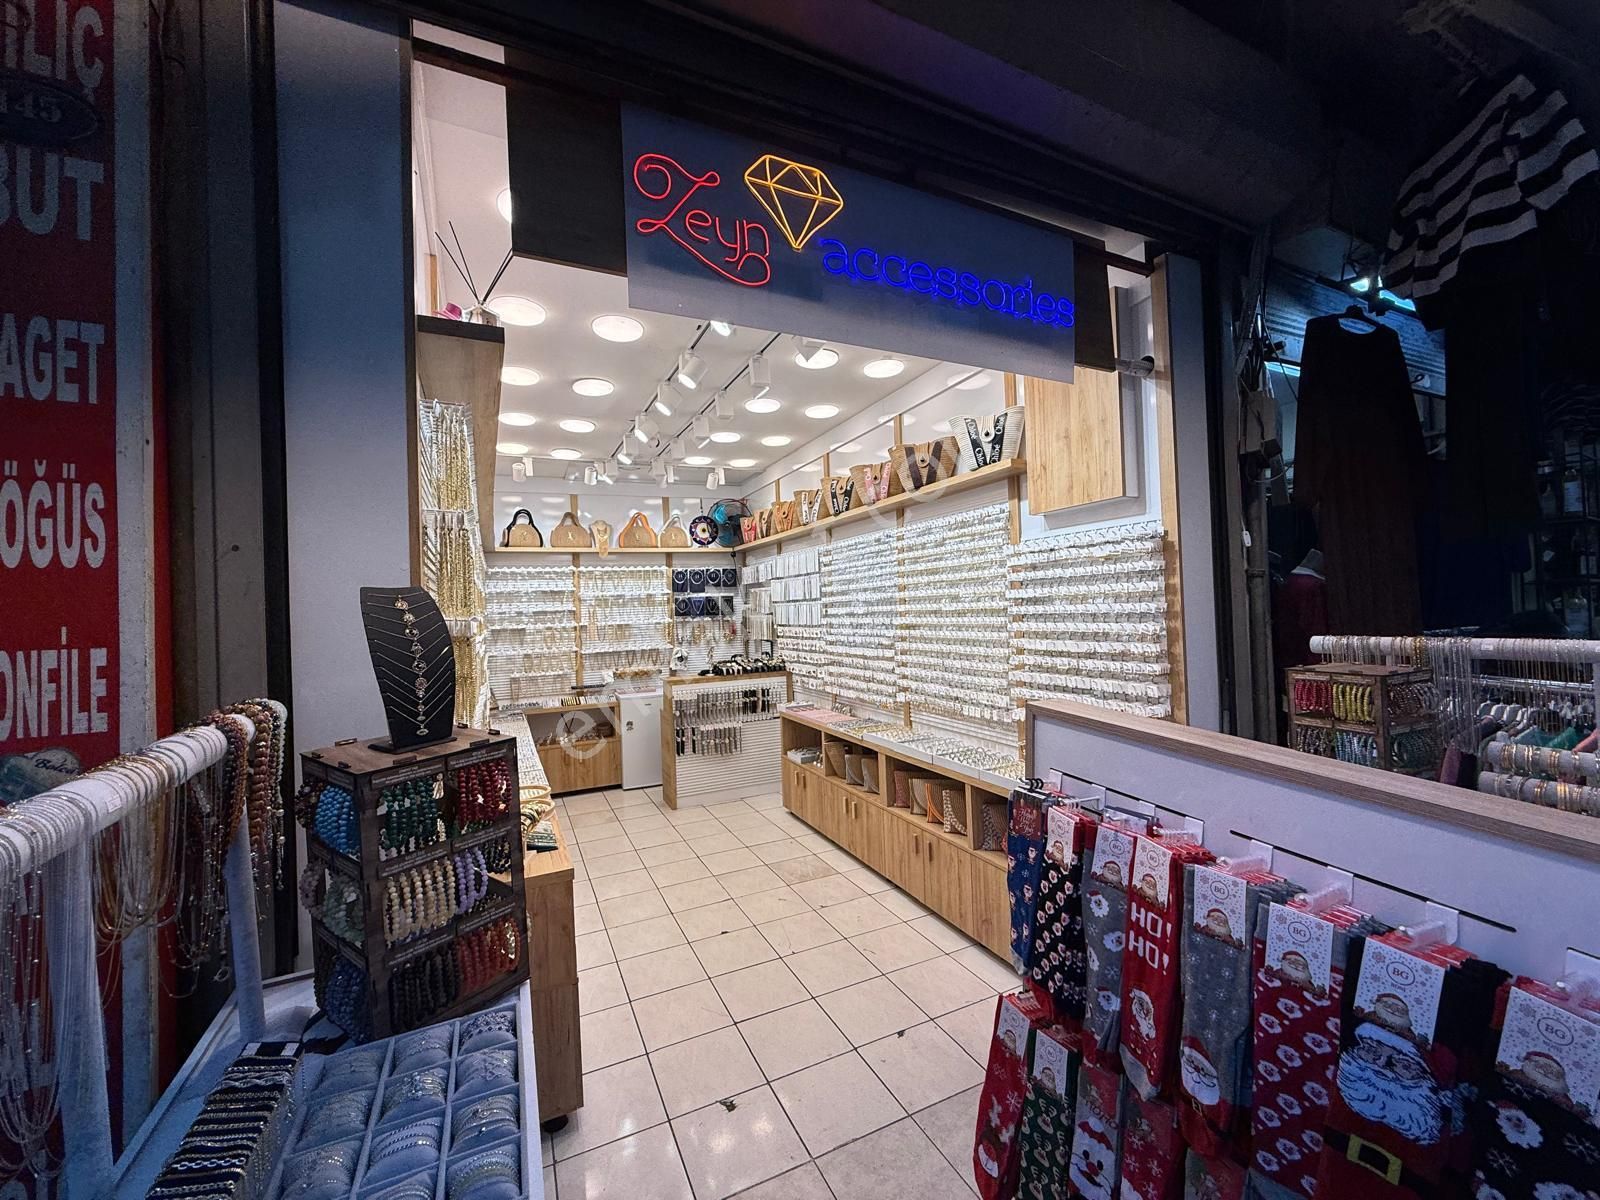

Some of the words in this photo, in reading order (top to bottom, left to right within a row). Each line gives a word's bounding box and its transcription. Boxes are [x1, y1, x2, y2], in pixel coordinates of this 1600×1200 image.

[632, 153, 771, 287] Zeyn
[819, 238, 1076, 328] accessories
[1128, 929, 1170, 976] HO!
[1130, 901, 1172, 944] HO!
